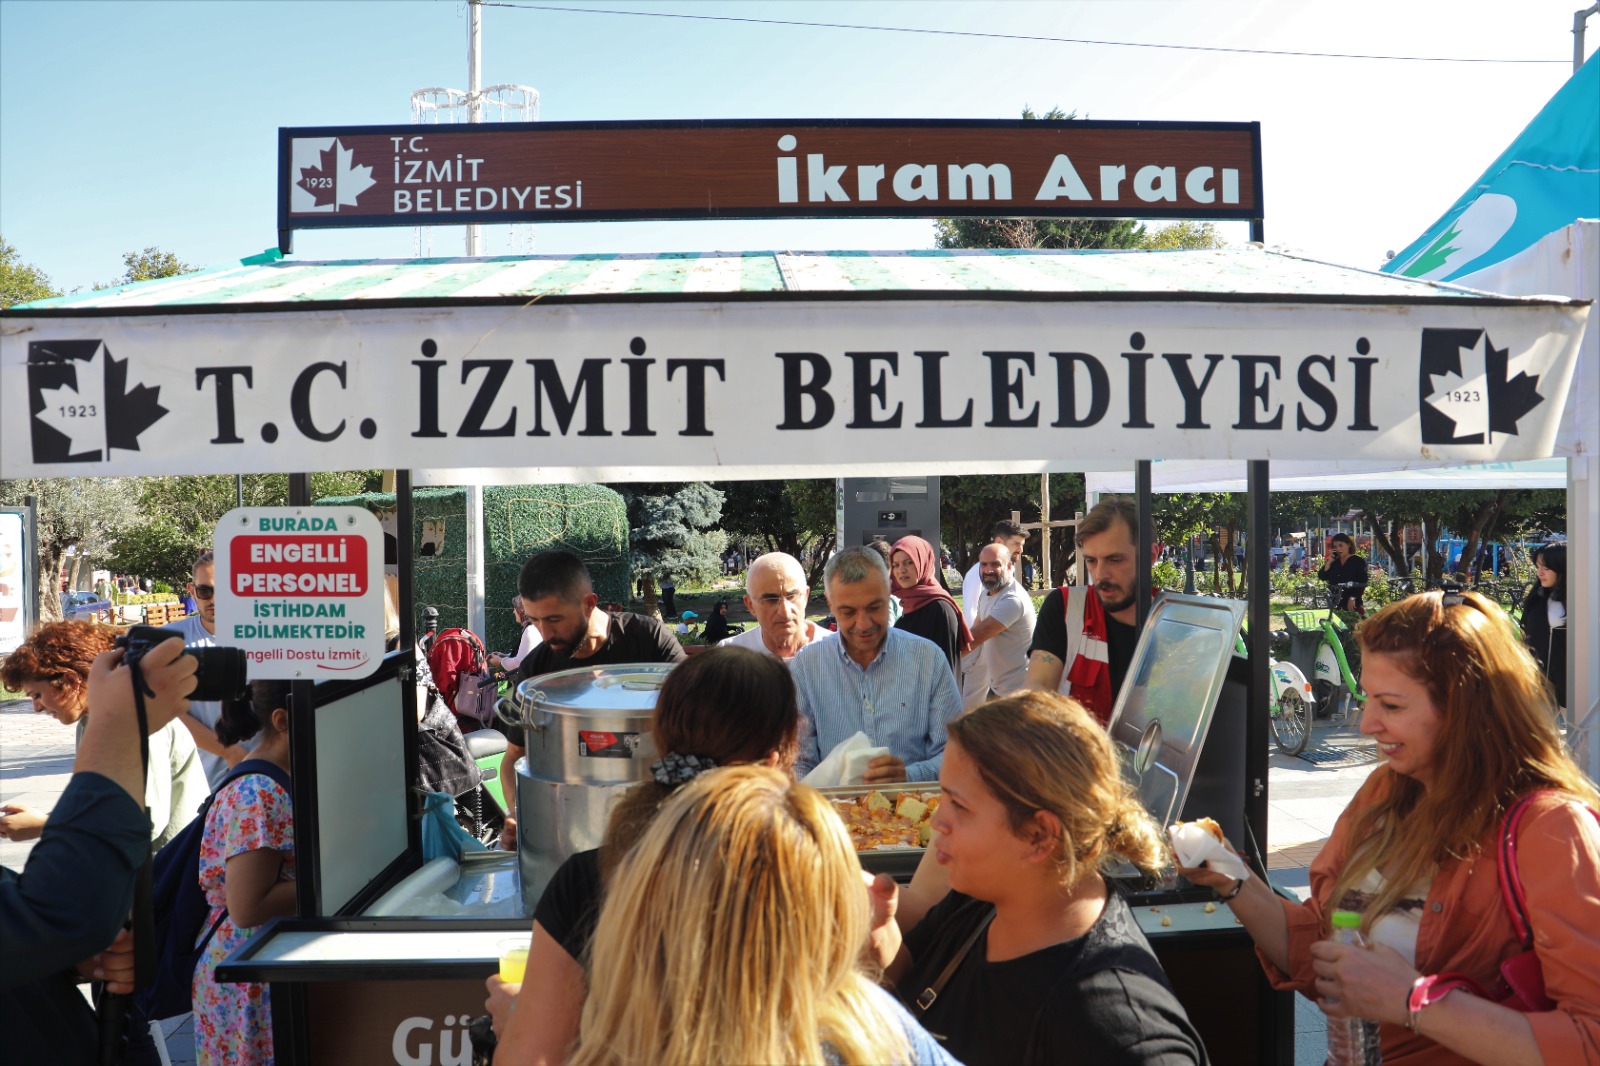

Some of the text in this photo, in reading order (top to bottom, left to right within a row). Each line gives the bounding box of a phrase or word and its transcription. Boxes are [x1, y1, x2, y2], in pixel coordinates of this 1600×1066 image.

[390, 136, 428, 153] T.C.
[393, 153, 485, 184] İZMİT
[777, 134, 1240, 204] İkram Aracı
[305, 177, 333, 189] 1923
[195, 331, 1379, 444] T.C. İZMİT BELEDİYESİ
[1446, 390, 1481, 403] 1923
[58, 404, 97, 418] 1923
[259, 517, 338, 532] BURADA
[250, 537, 348, 563] ENGELLİ
[236, 573, 362, 593] PERSONEL
[253, 599, 346, 618] İSTİHDAM
[234, 620, 366, 639] EDİLMEKTEDİR
[246, 647, 361, 663] ngelli Dostu İzmit
